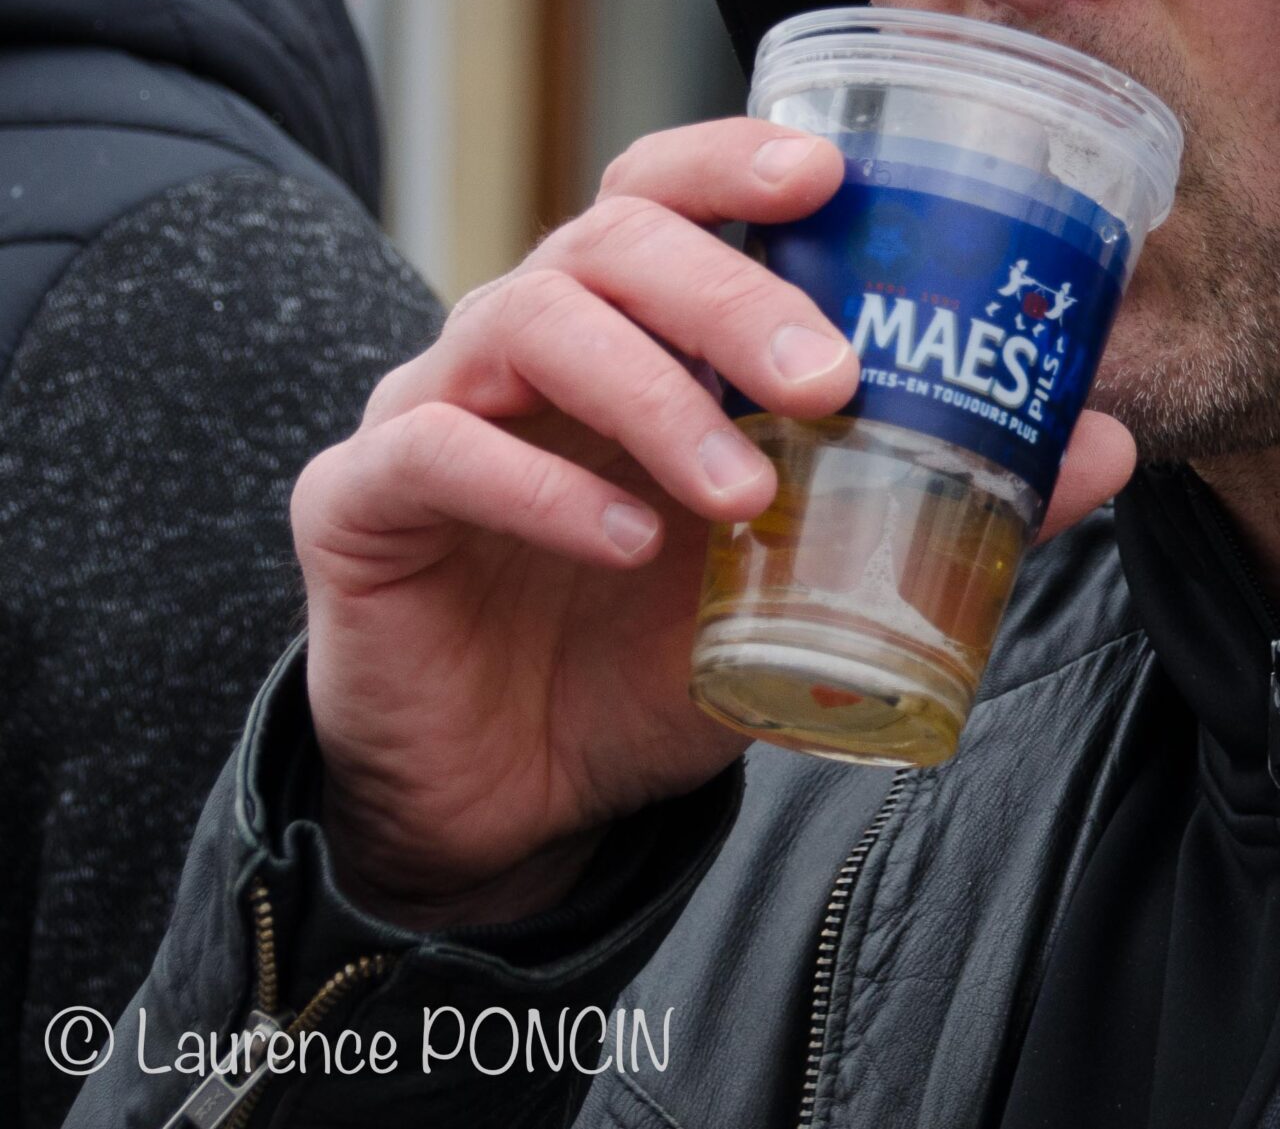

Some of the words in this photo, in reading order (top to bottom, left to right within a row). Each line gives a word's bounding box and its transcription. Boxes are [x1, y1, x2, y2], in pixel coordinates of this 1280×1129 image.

[851, 292, 1039, 410] MAES
[932, 381, 1009, 427] TOUJOURS
[1008, 416, 1039, 444] PLUS
[1027, 353, 1060, 422] PILS
